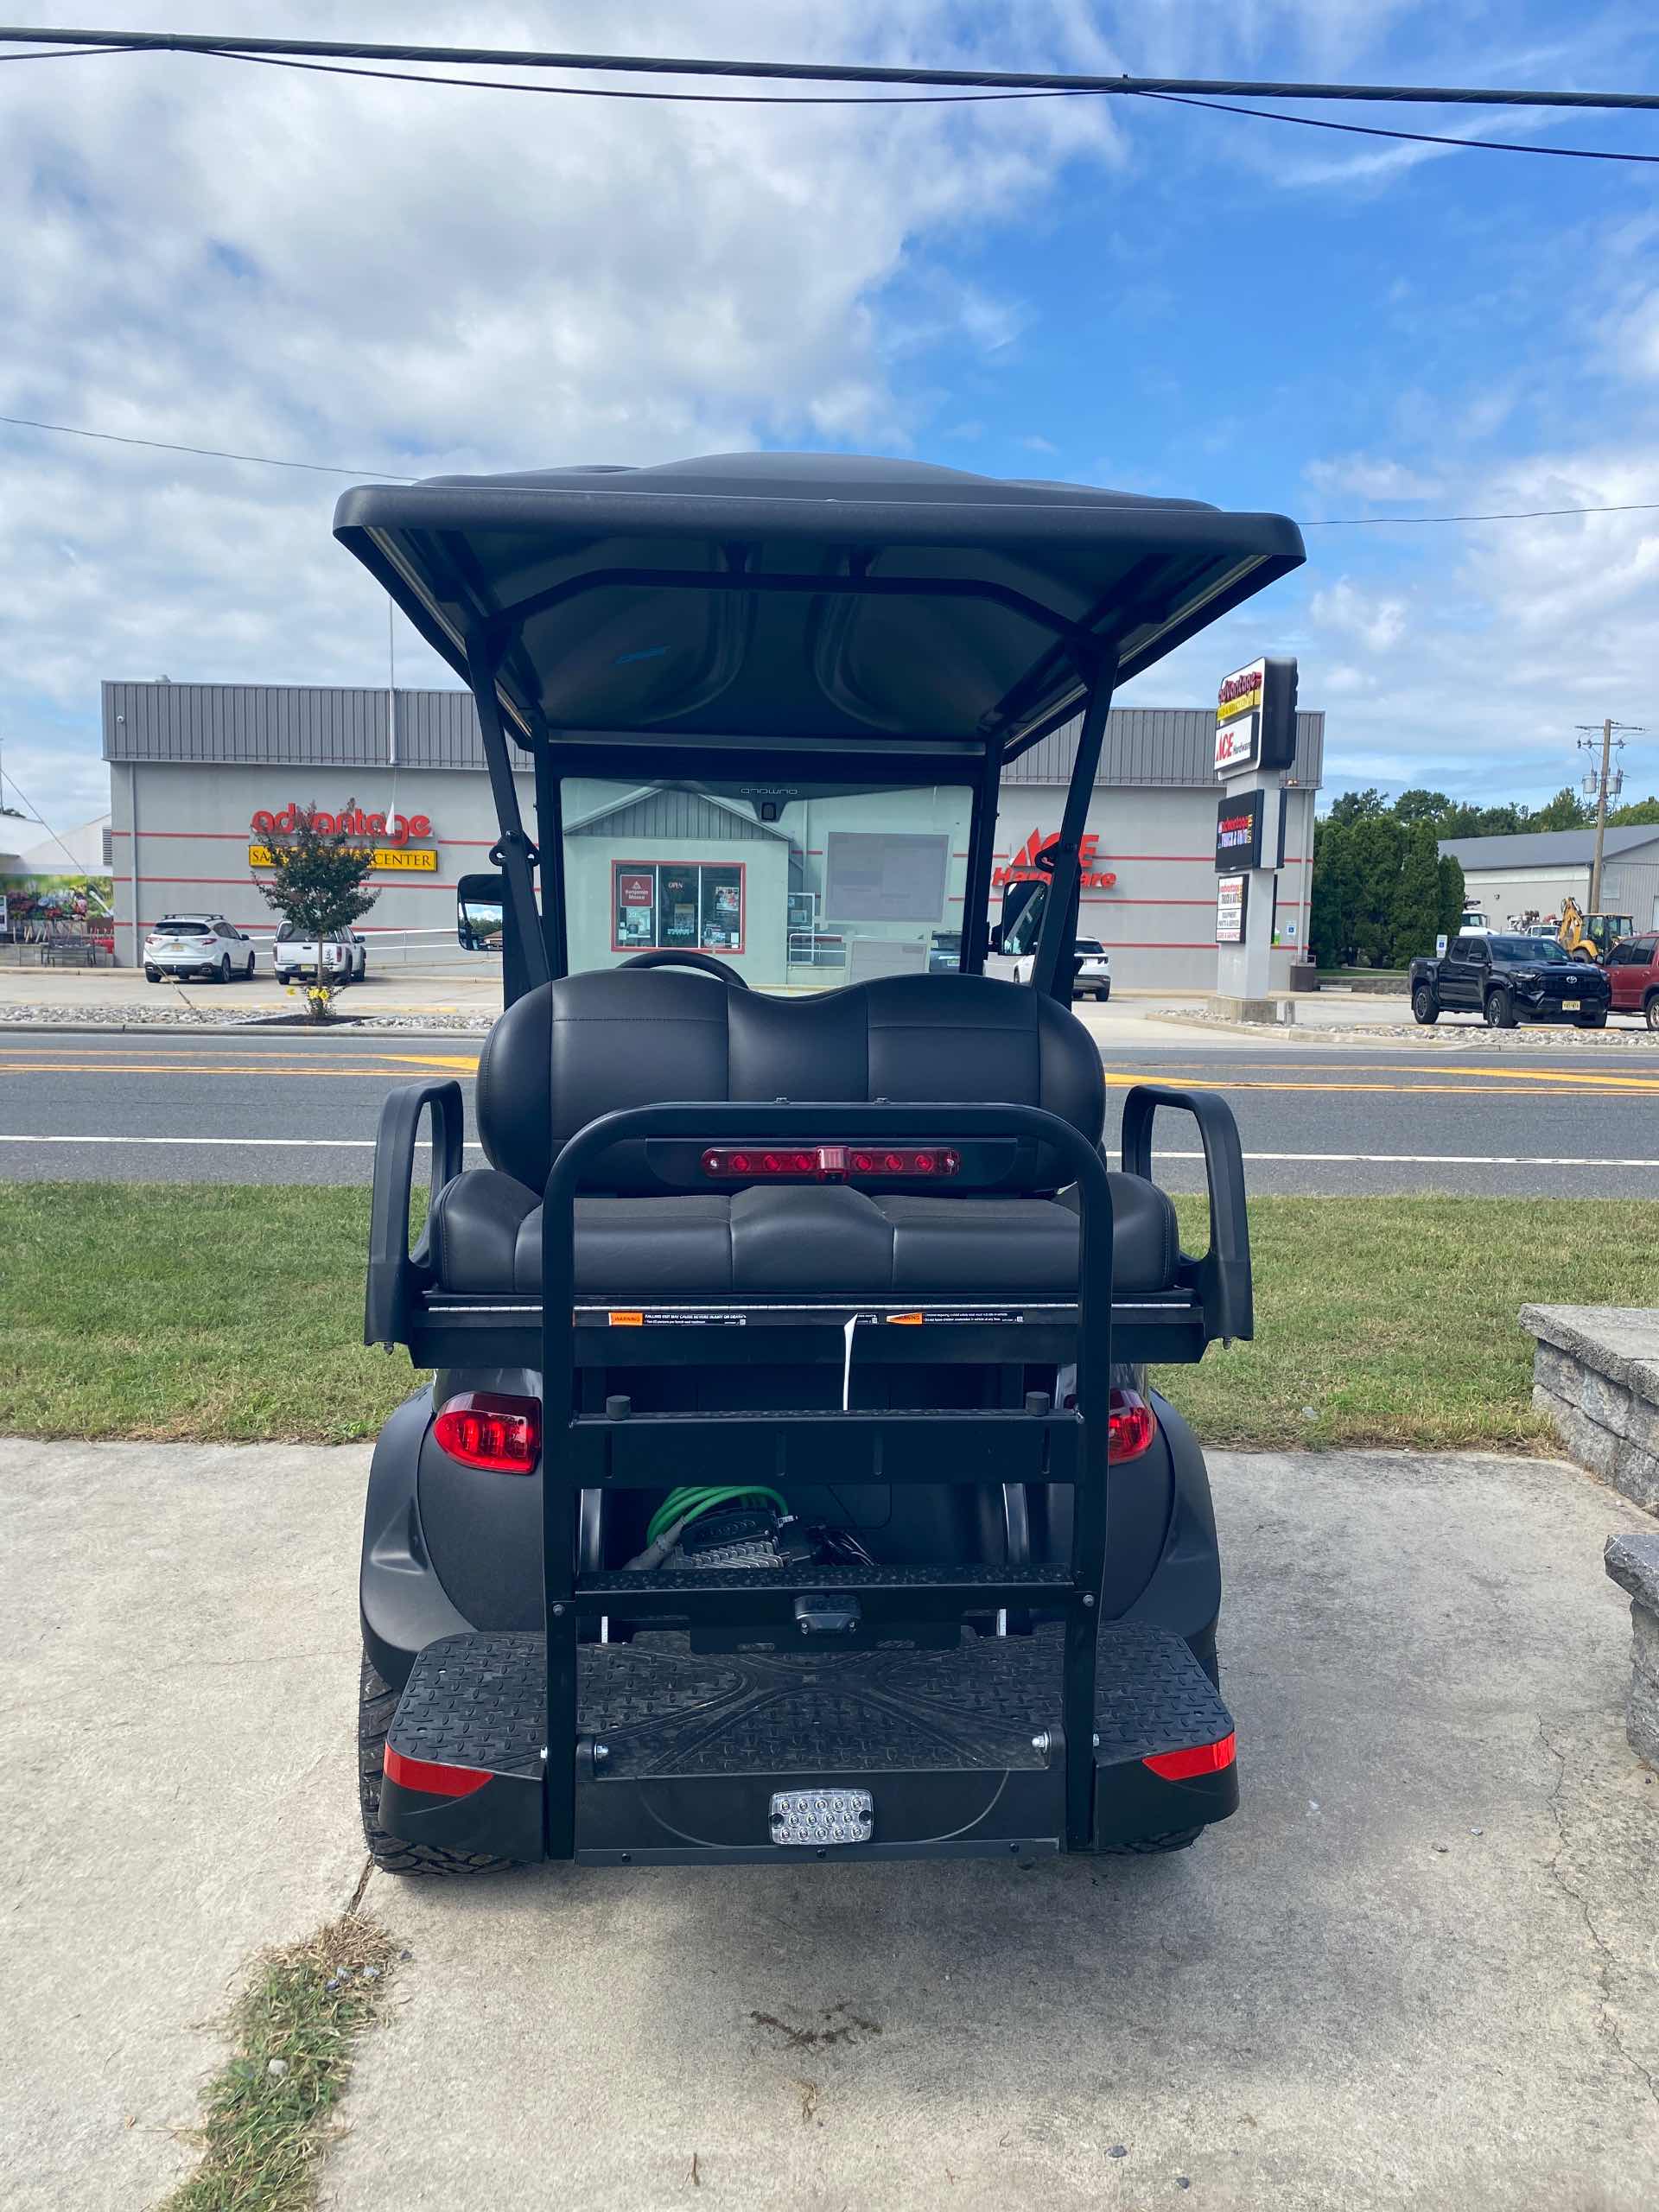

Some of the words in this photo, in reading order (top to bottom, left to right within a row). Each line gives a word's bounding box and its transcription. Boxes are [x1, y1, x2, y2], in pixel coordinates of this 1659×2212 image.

[1218, 671, 1260, 703] advantage
[1216, 732, 1234, 761] ACE
[1233, 741, 1251, 754] Hardware
[373, 852, 431, 866] CENTER
[992, 867, 1116, 886] Hardare
